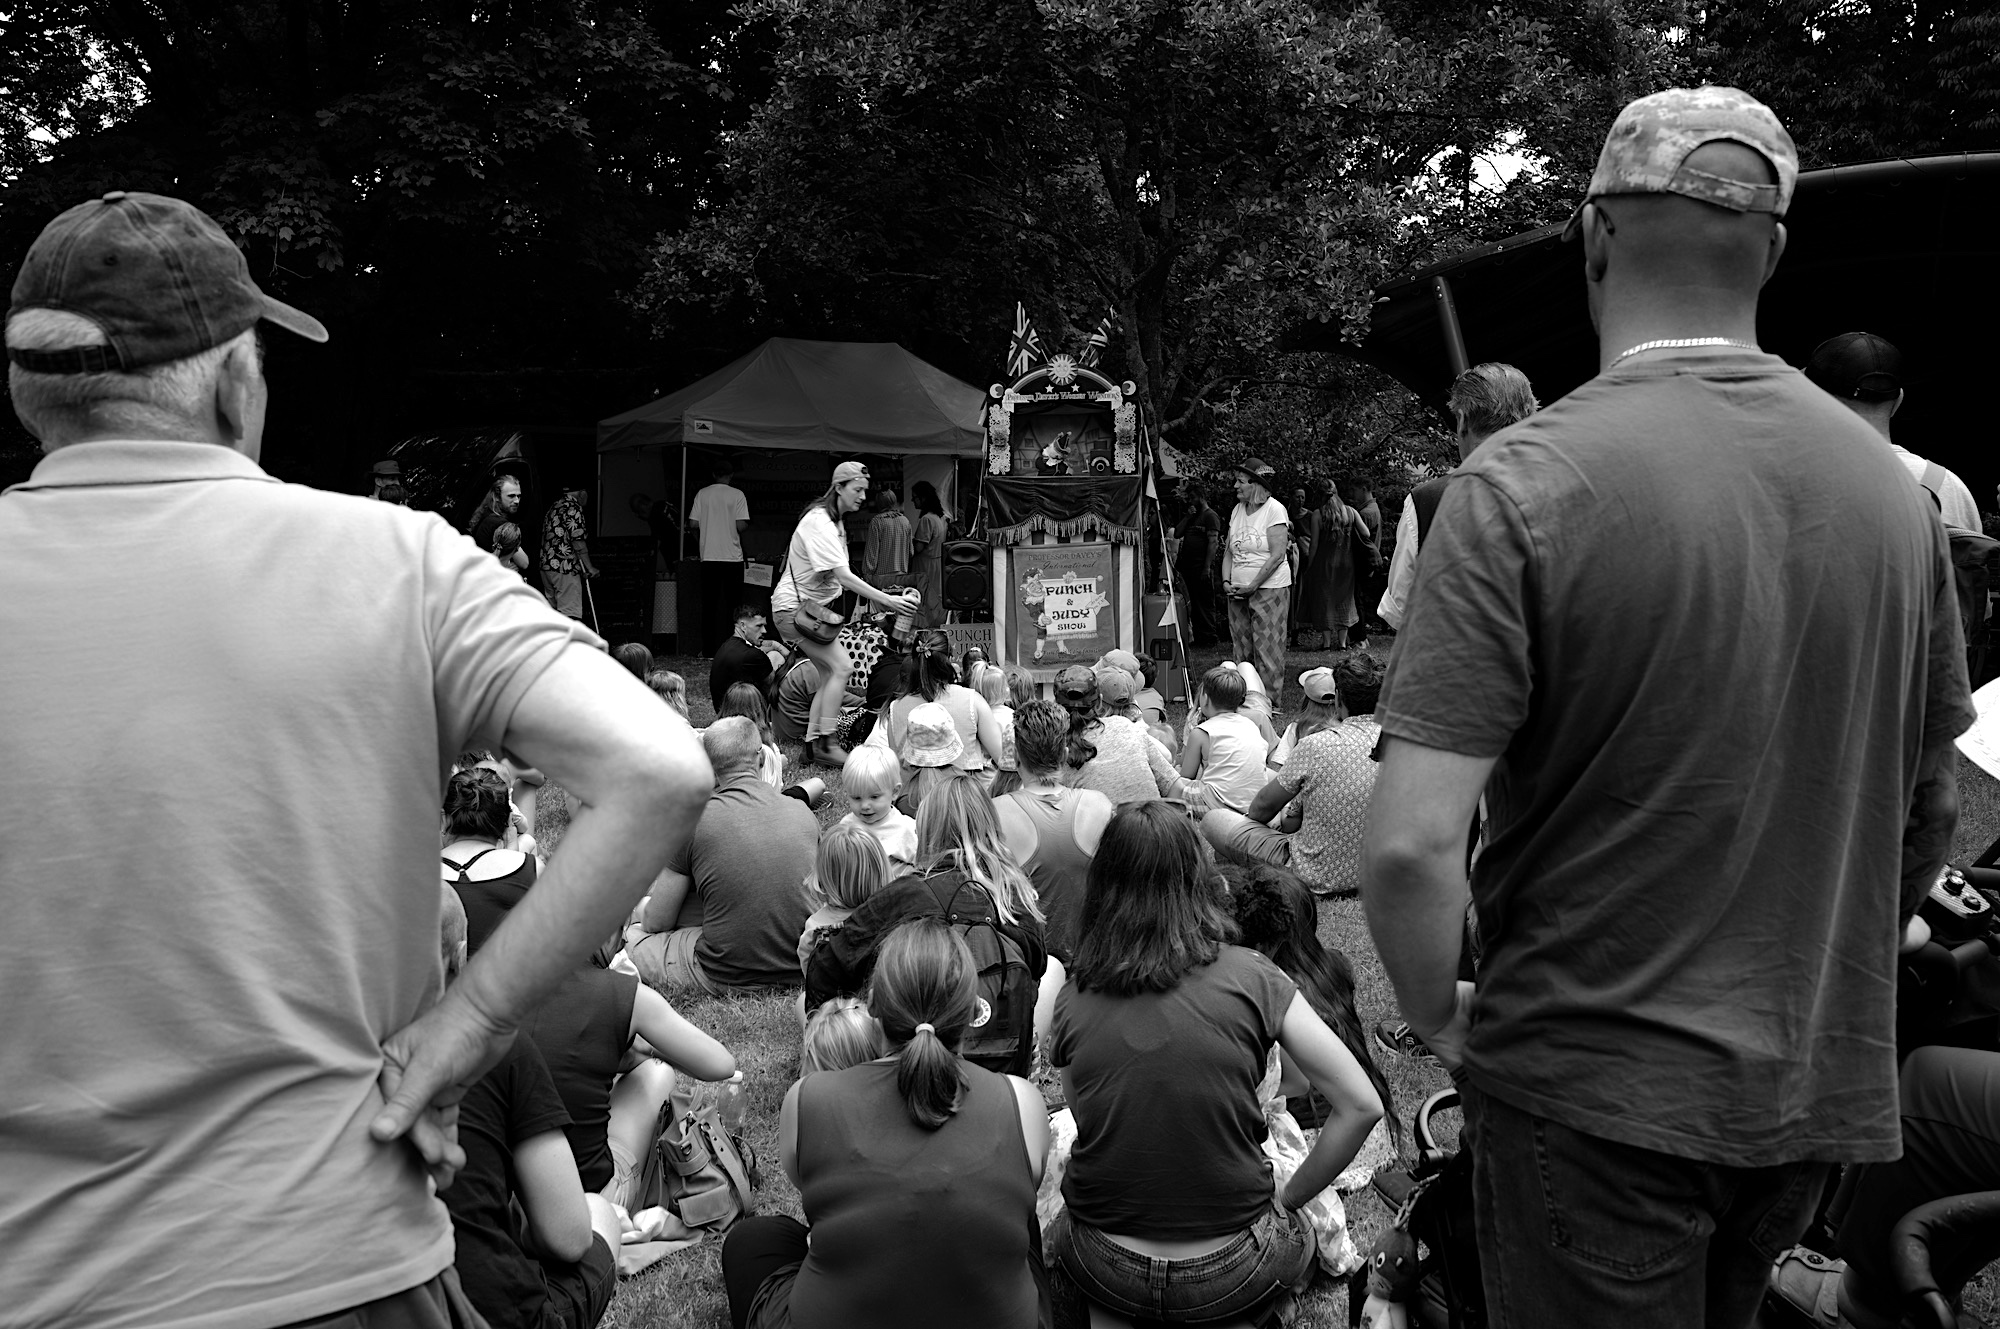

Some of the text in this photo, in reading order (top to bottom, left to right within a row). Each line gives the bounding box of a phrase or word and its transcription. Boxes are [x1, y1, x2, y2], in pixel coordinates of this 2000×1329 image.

[1029, 551, 1102, 561] PROFESSOR DAVEY'S
[1042, 560, 1097, 570] International
[1045, 583, 1093, 596] PUNCH
[1052, 608, 1090, 621] JUDY
[1057, 622, 1087, 631] SHOW
[947, 628, 992, 642] PUNCH
